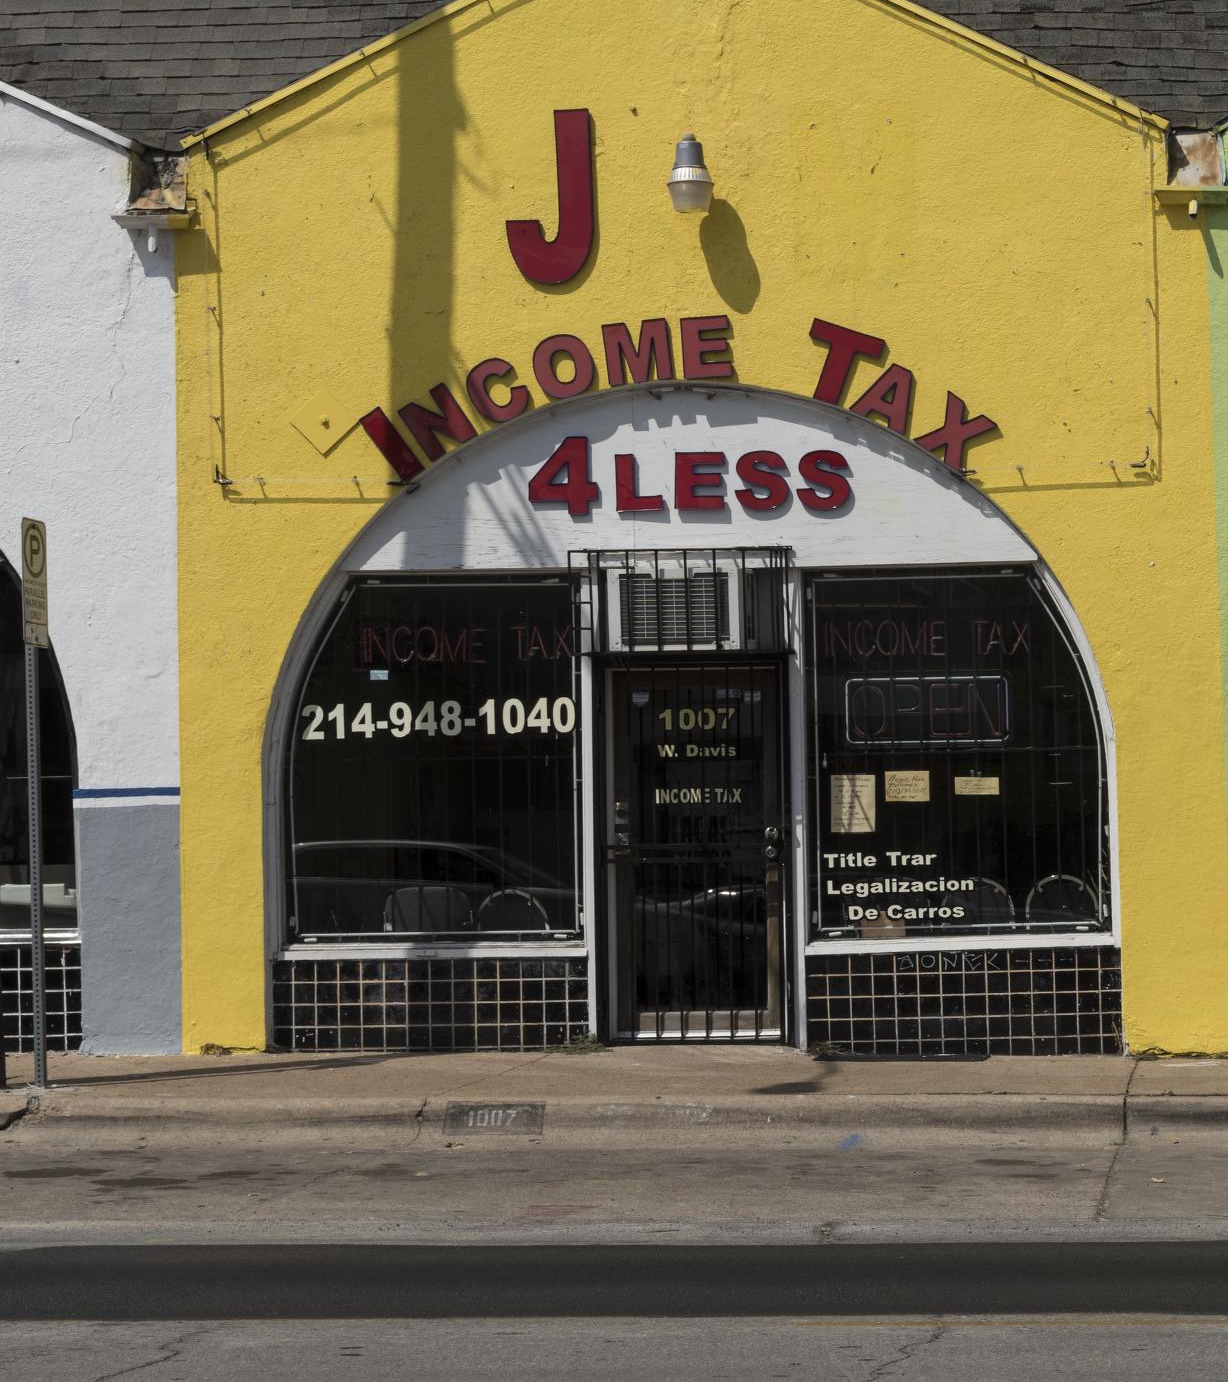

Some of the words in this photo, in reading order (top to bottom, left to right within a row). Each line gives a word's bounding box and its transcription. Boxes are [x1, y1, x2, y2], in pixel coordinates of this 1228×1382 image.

[506, 108, 595, 285] J
[359, 315, 737, 482] INCOME
[808, 317, 999, 472] TAX
[362, 625, 487, 664] INCOME
[510, 624, 573, 661] TAX
[824, 620, 946, 657] INCOME
[973, 620, 1031, 656] TAX
[301, 696, 576, 741] 214-948-1040
[658, 707, 736, 731] 1007
[852, 683, 1003, 728] OPEN
[657, 744, 679, 758] W.
[686, 744, 737, 758] Davis
[655, 788, 711, 805] INCOME
[714, 788, 743, 804] TAX
[823, 852, 877, 869] Title
[885, 851, 938, 867] Trar
[826, 877, 975, 898] Legalizacion
[847, 905, 879, 921] De
[887, 902, 966, 919] Carros
